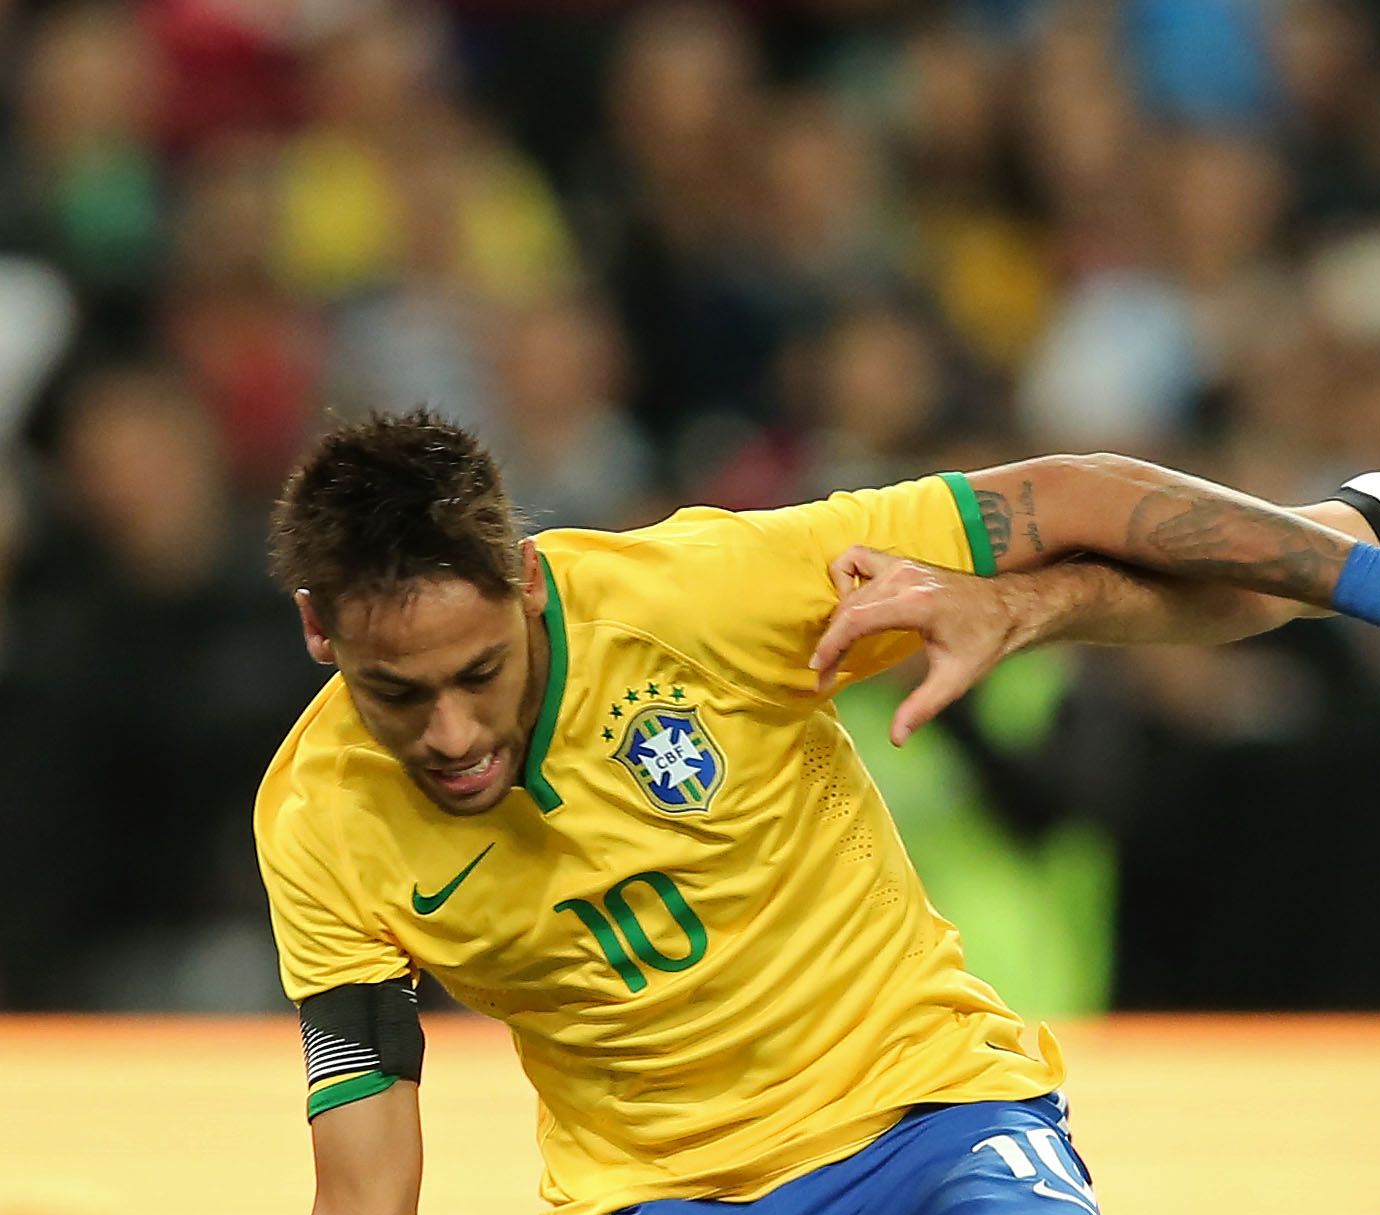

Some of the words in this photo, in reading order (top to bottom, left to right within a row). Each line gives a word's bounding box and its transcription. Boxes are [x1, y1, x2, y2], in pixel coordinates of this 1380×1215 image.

[655, 745, 685, 769] CBF
[554, 870, 708, 993] 10
[972, 1128, 1098, 1208] 10
